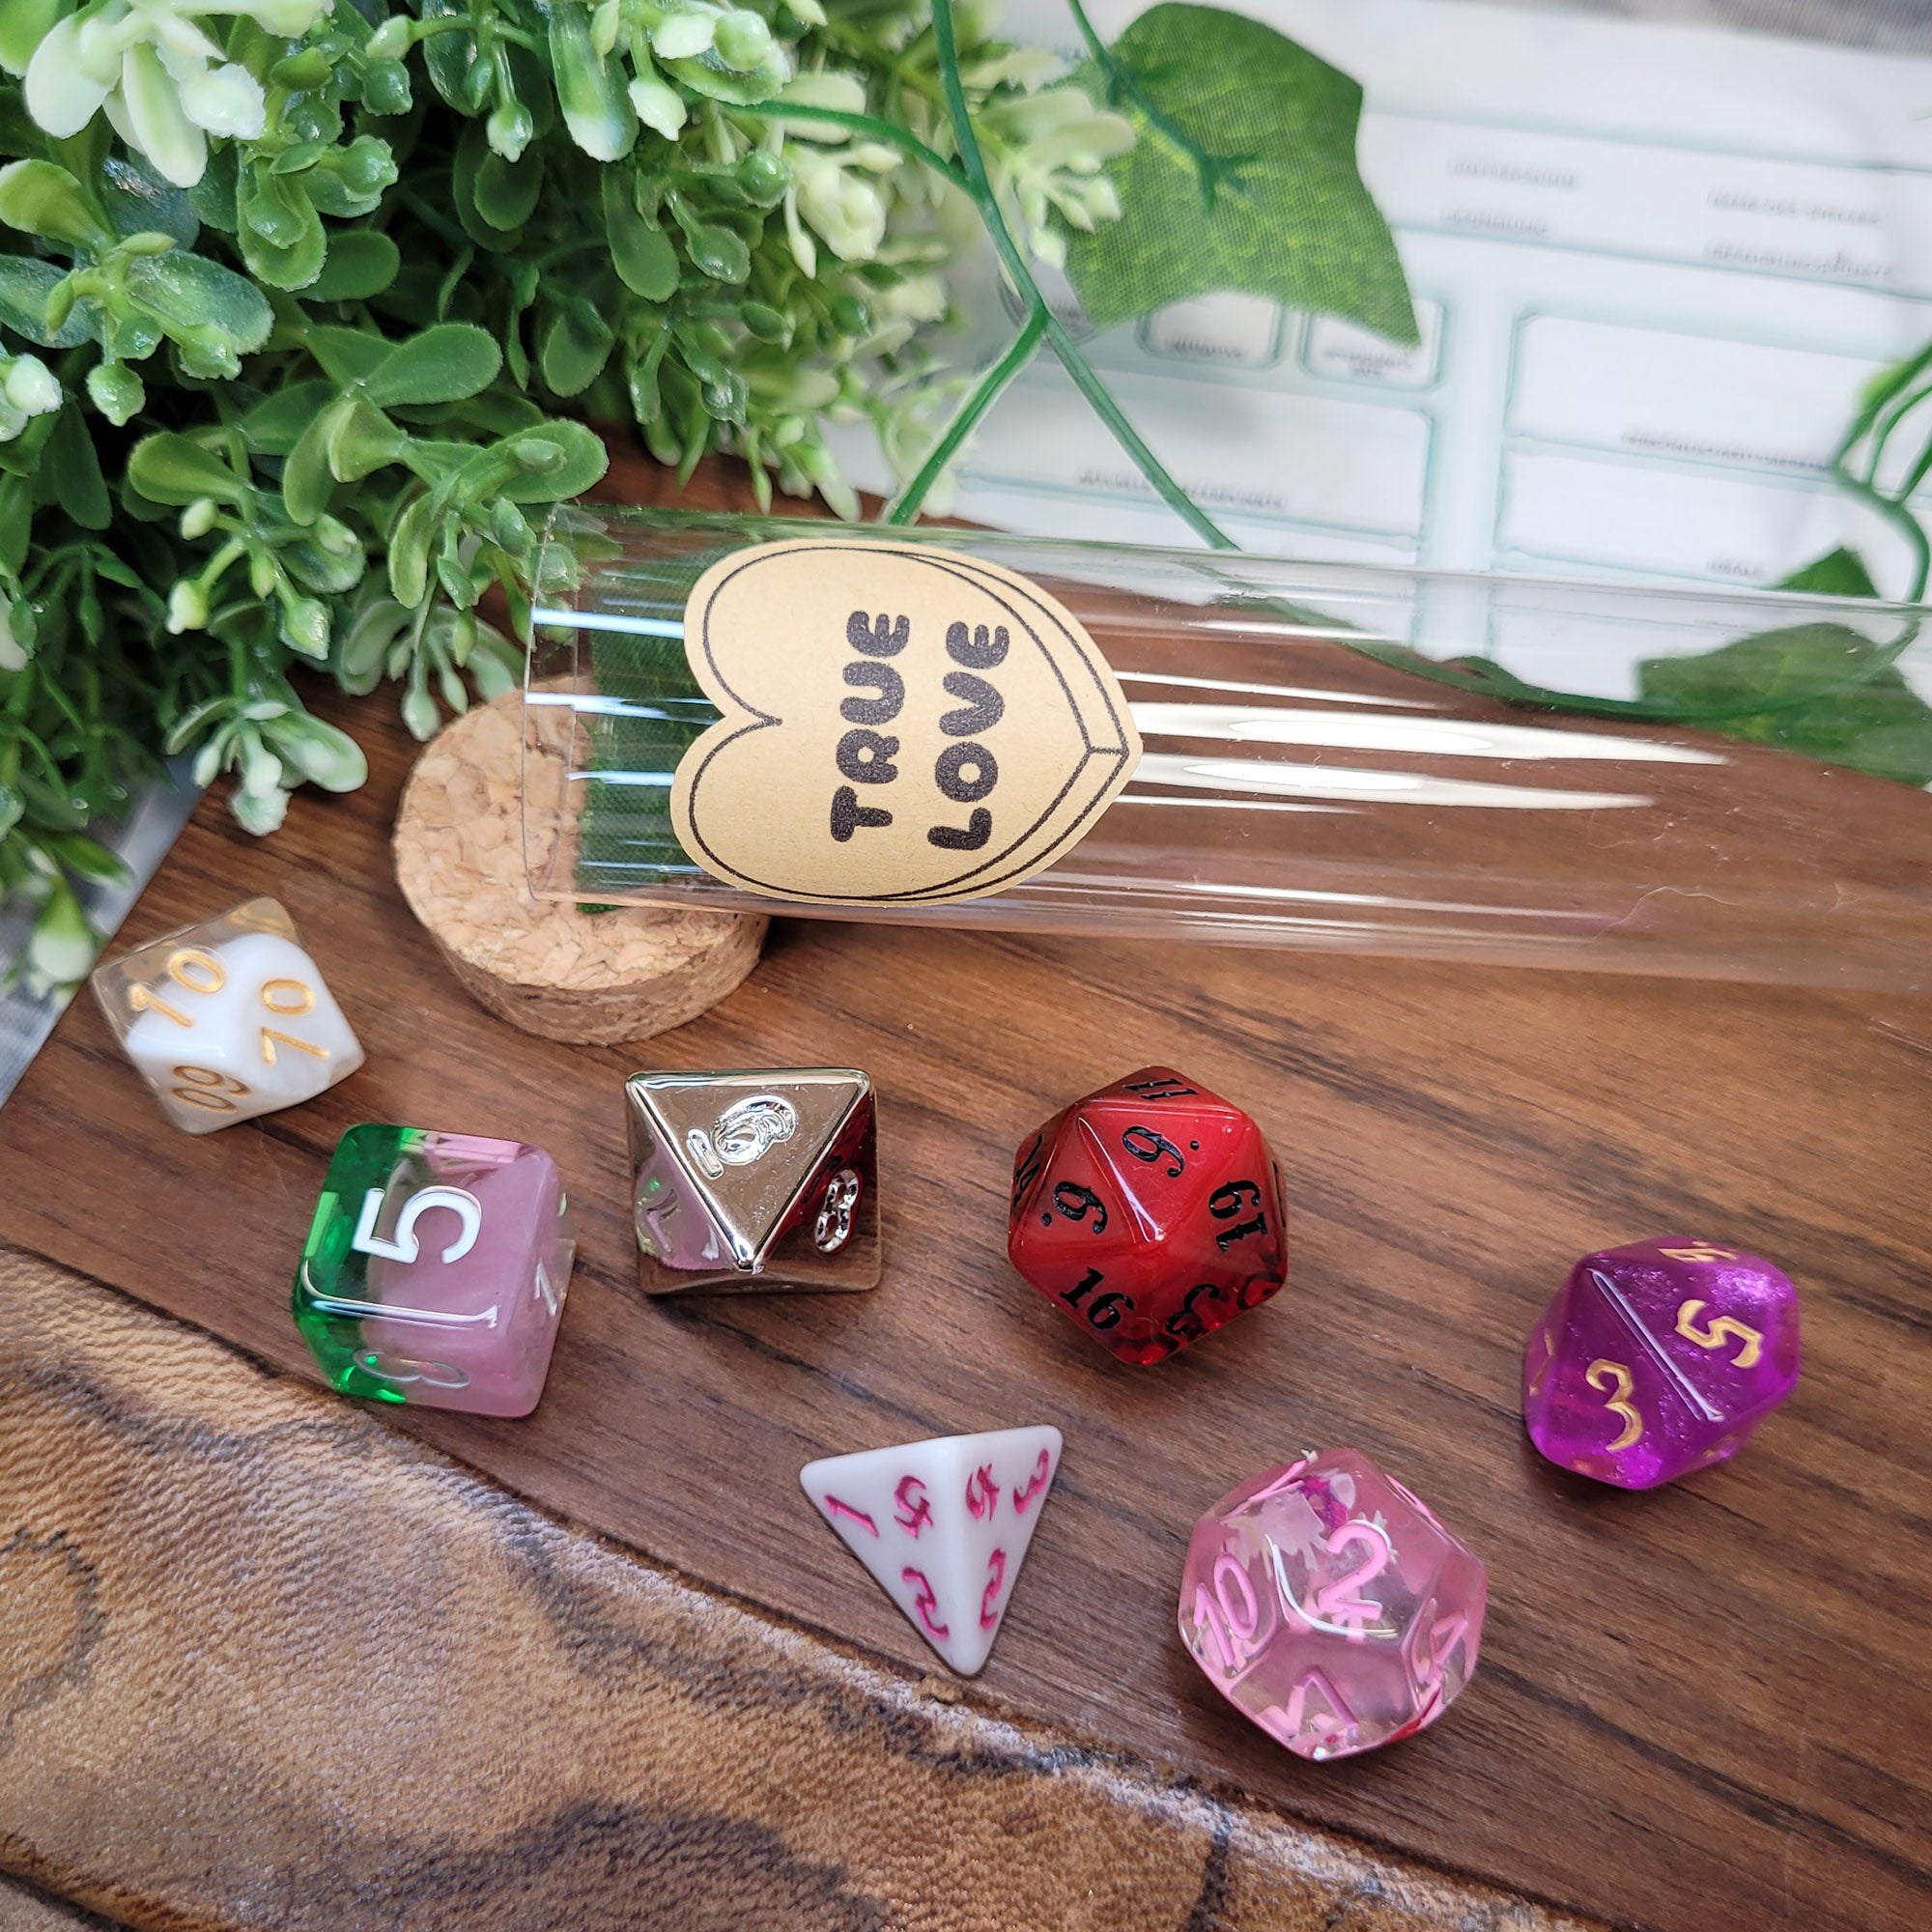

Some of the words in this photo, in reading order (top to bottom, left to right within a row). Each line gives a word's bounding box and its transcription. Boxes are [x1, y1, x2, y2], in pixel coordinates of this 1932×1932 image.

[831, 610, 910, 842] TRUE
[927, 621, 1010, 850] LOVE
[128, 948, 226, 1028] 10
[261, 978, 331, 1067] 70
[351, 1184, 482, 1264] 5
[813, 1168, 863, 1256] 8
[1059, 1265, 1136, 1330] 16
[1673, 1298, 1764, 1369] 5
[1584, 1357, 1643, 1452] 3
[824, 1493, 880, 1539] 1
[901, 1566, 951, 1639] 2
[1193, 1551, 1259, 1667] 10
[1318, 1519, 1392, 1621] 2
